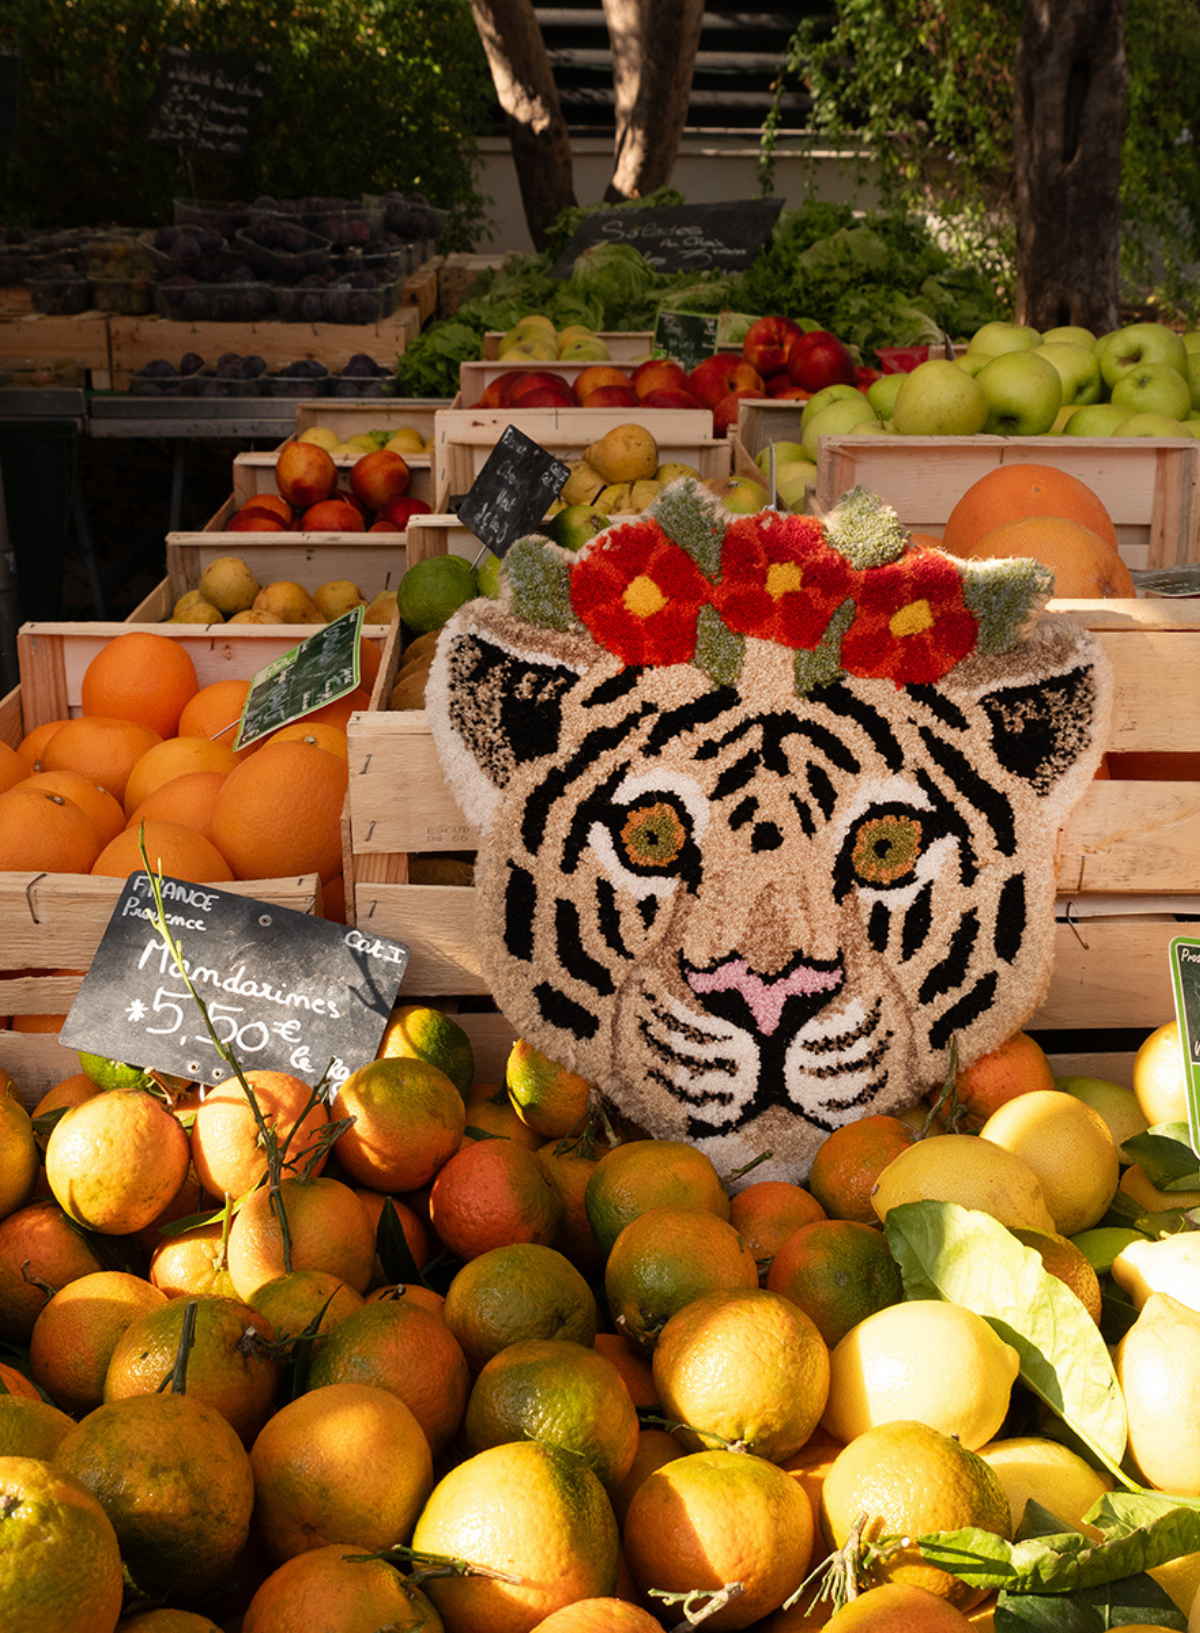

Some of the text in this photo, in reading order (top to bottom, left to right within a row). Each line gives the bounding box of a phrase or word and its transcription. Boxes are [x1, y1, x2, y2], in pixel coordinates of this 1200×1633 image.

[426, 825, 475, 835] ESCUD
[133, 875, 219, 912] FRANCE
[122, 896, 207, 931] Provence
[344, 930, 386, 958] Cat
[138, 938, 340, 1018] Mandarines
[290, 1045, 316, 1073] le
